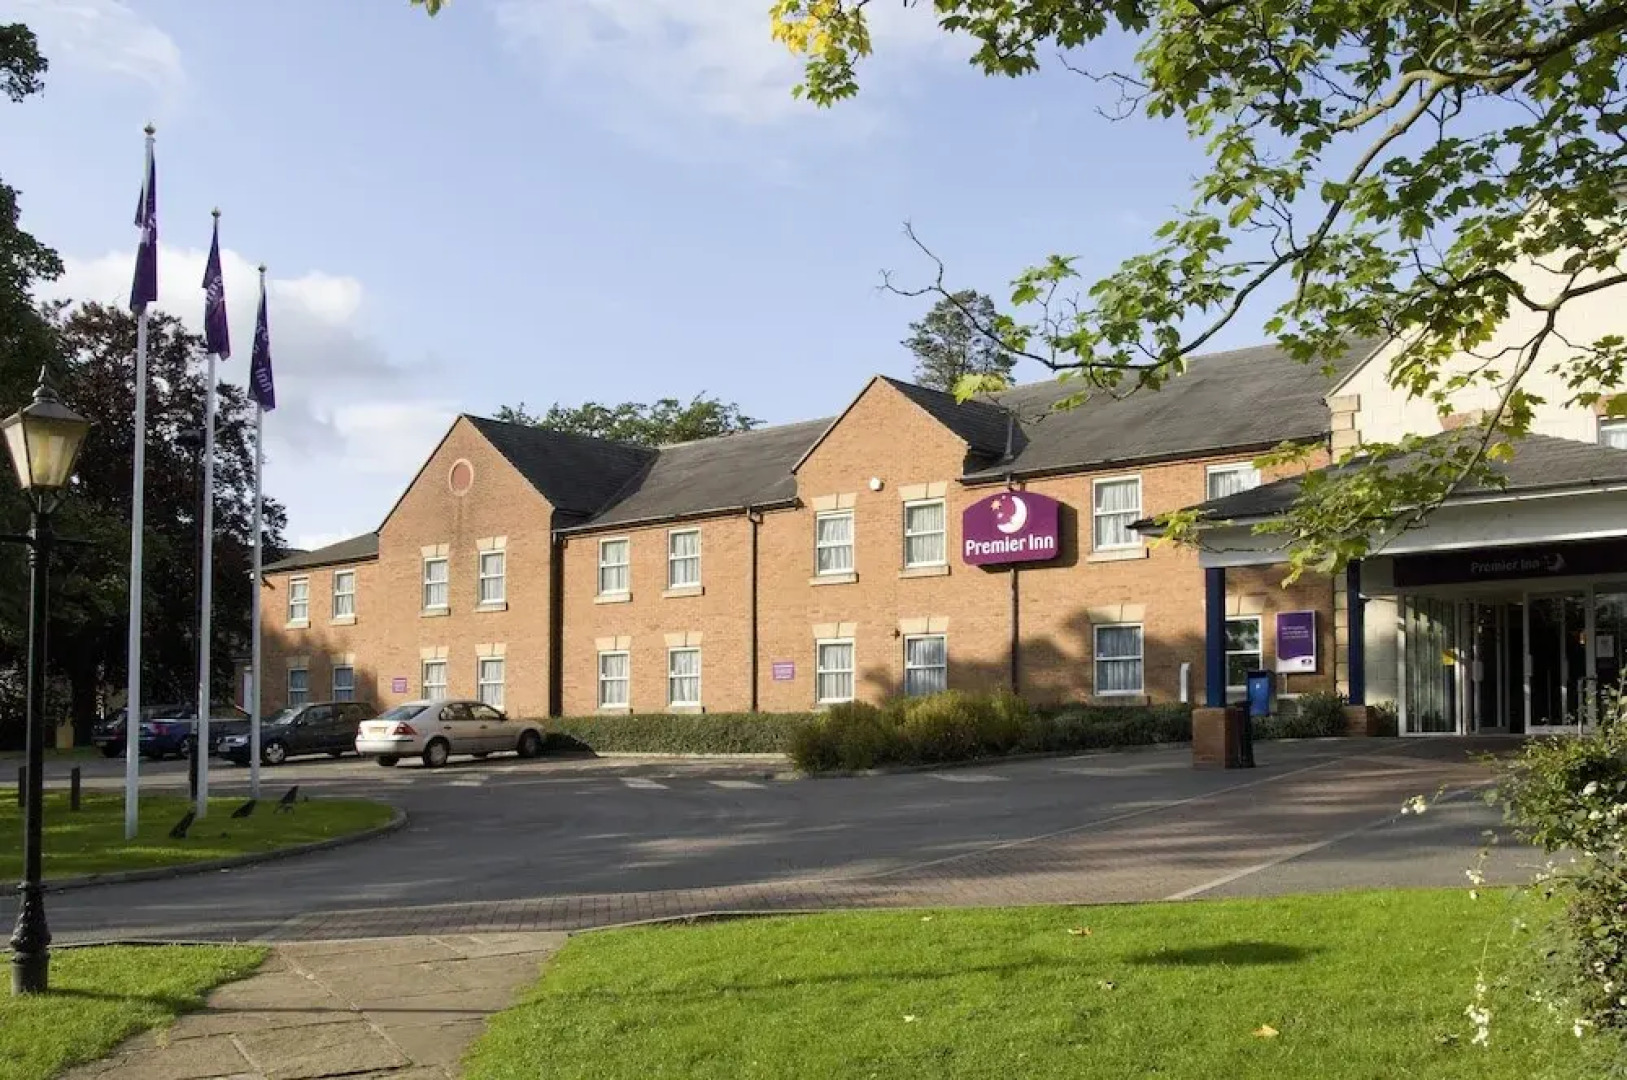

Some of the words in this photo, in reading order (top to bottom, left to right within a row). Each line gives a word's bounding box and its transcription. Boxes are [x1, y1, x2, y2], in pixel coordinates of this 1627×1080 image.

[965, 536, 1026, 556] Premier
[1029, 533, 1054, 550] Inn
[1471, 560, 1518, 573] Premier
[1521, 559, 1539, 570] Inn
